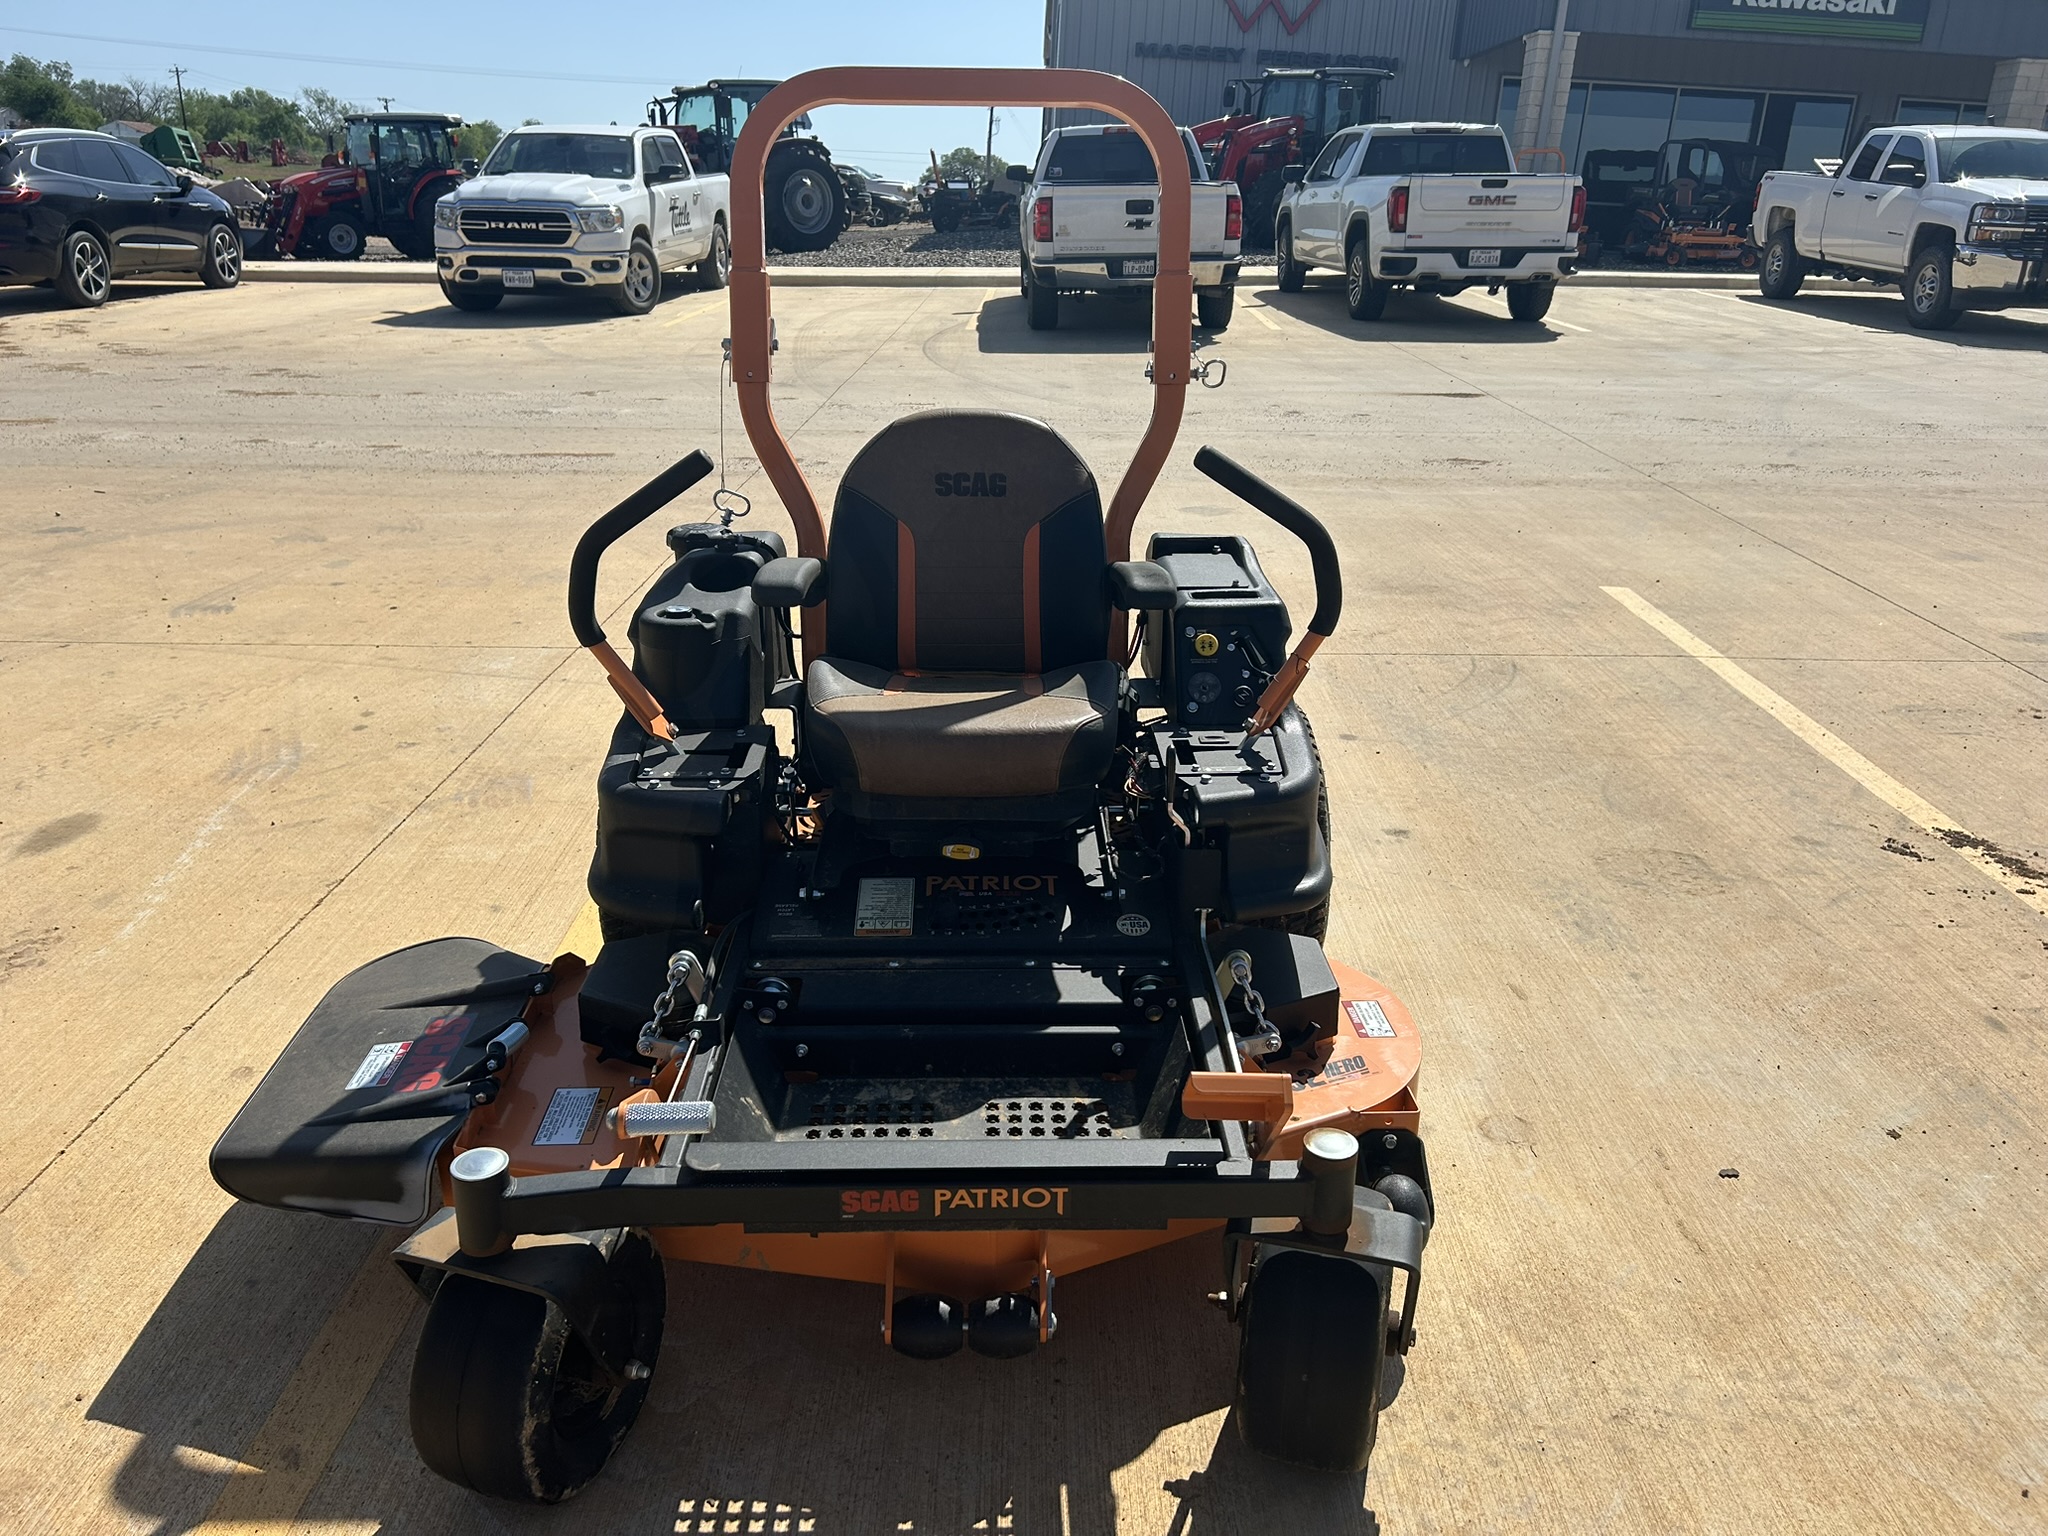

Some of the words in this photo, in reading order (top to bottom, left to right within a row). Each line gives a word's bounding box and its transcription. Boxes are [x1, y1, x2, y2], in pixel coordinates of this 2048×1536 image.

[1135, 42, 1246, 64] MASSEY
[1256, 49, 1399, 71] FERGUSON
[1468, 195, 1517, 206] GMC
[490, 221, 539, 230] RAM
[935, 472, 1007, 497] SCAG
[925, 875, 1060, 897] PATRIOT
[393, 1016, 471, 1093] SCAG
[1323, 1055, 1366, 1079] HERO
[841, 1190, 919, 1213] SCAG
[933, 1187, 1069, 1217] PATRIOT
